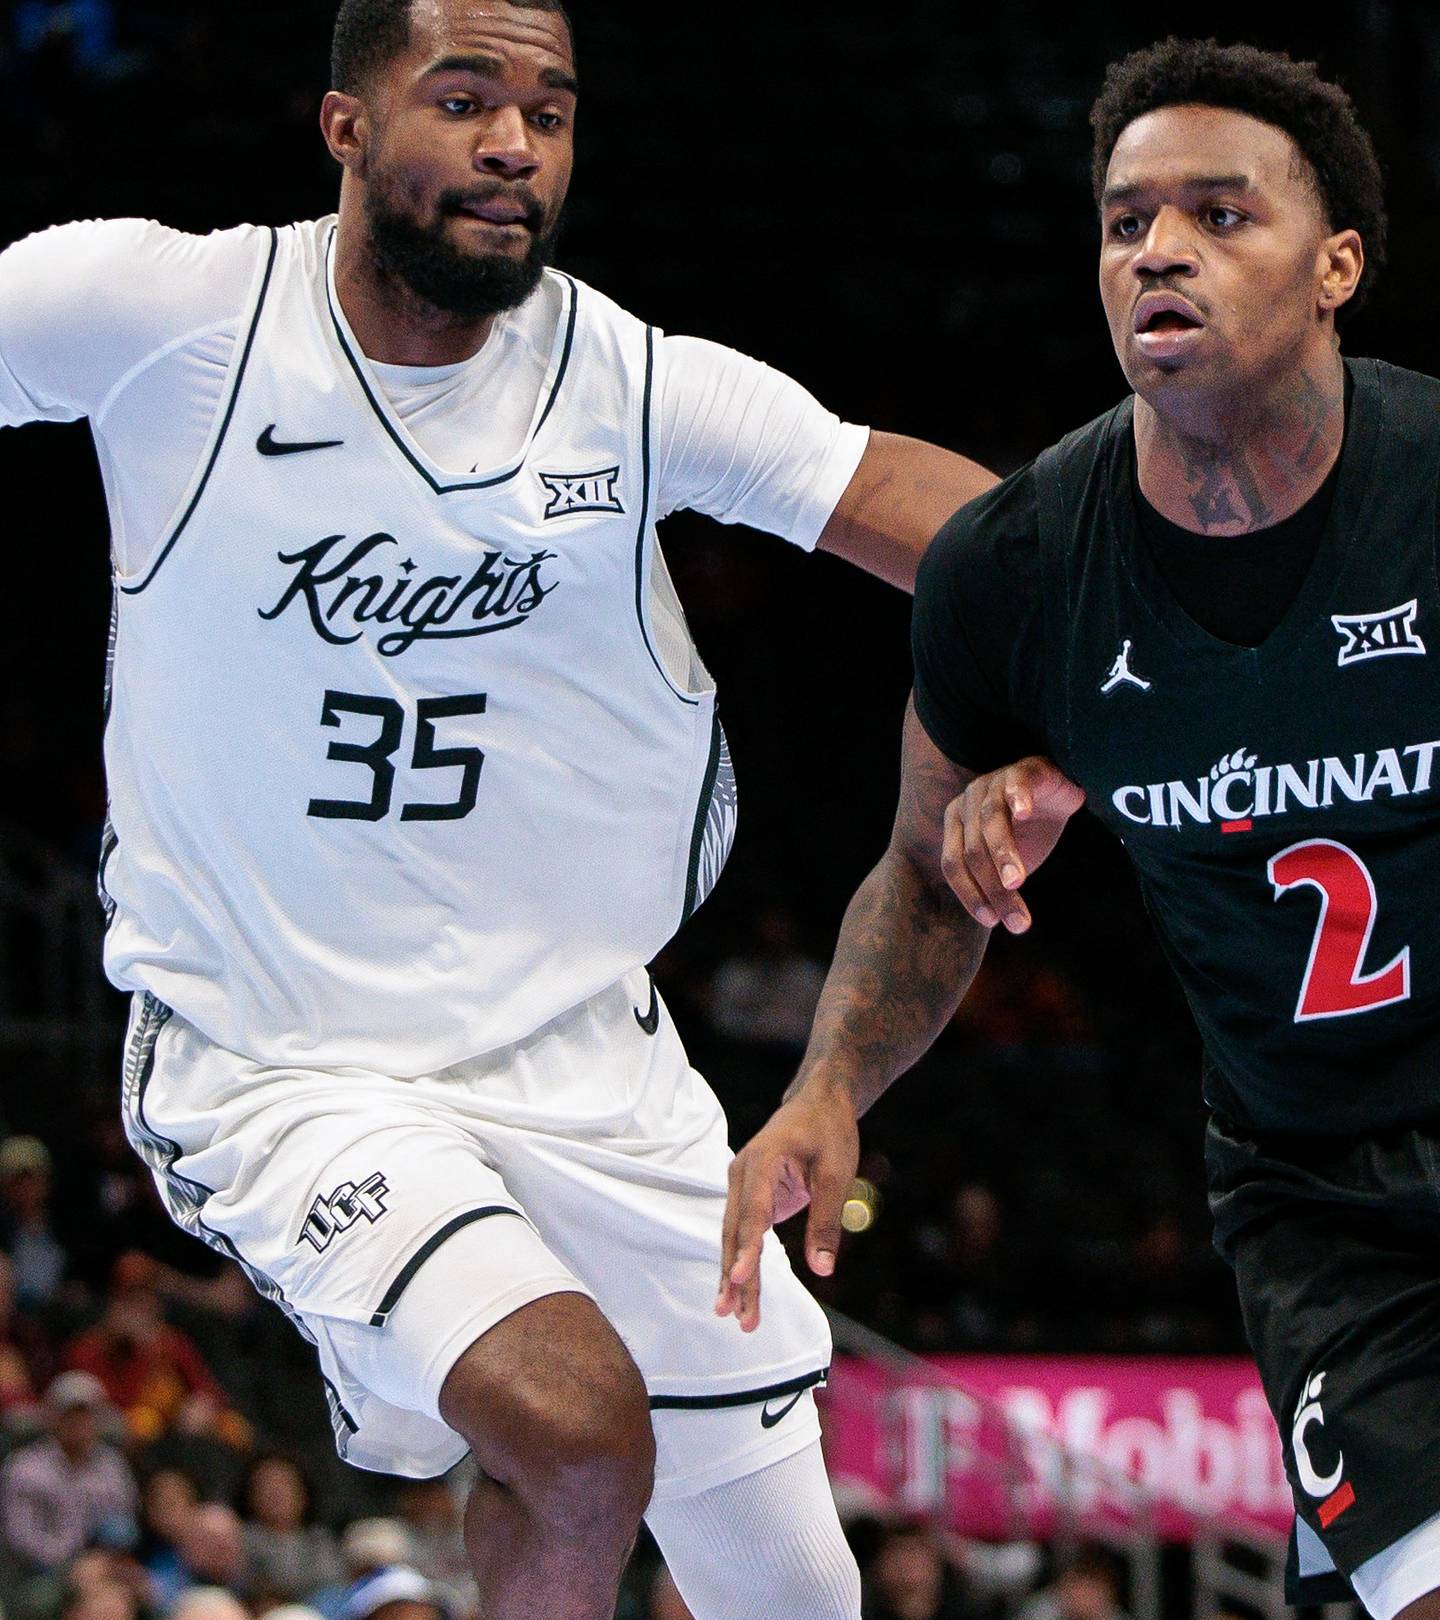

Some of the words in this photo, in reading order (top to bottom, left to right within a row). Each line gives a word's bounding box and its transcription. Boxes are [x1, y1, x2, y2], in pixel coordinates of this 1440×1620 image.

[539, 466, 626, 520] XII
[257, 532, 560, 657] Knights
[1331, 598, 1427, 667] XII
[306, 689, 488, 822] 35
[1267, 838, 1411, 1023] 2
[294, 1170, 390, 1254] UCF
